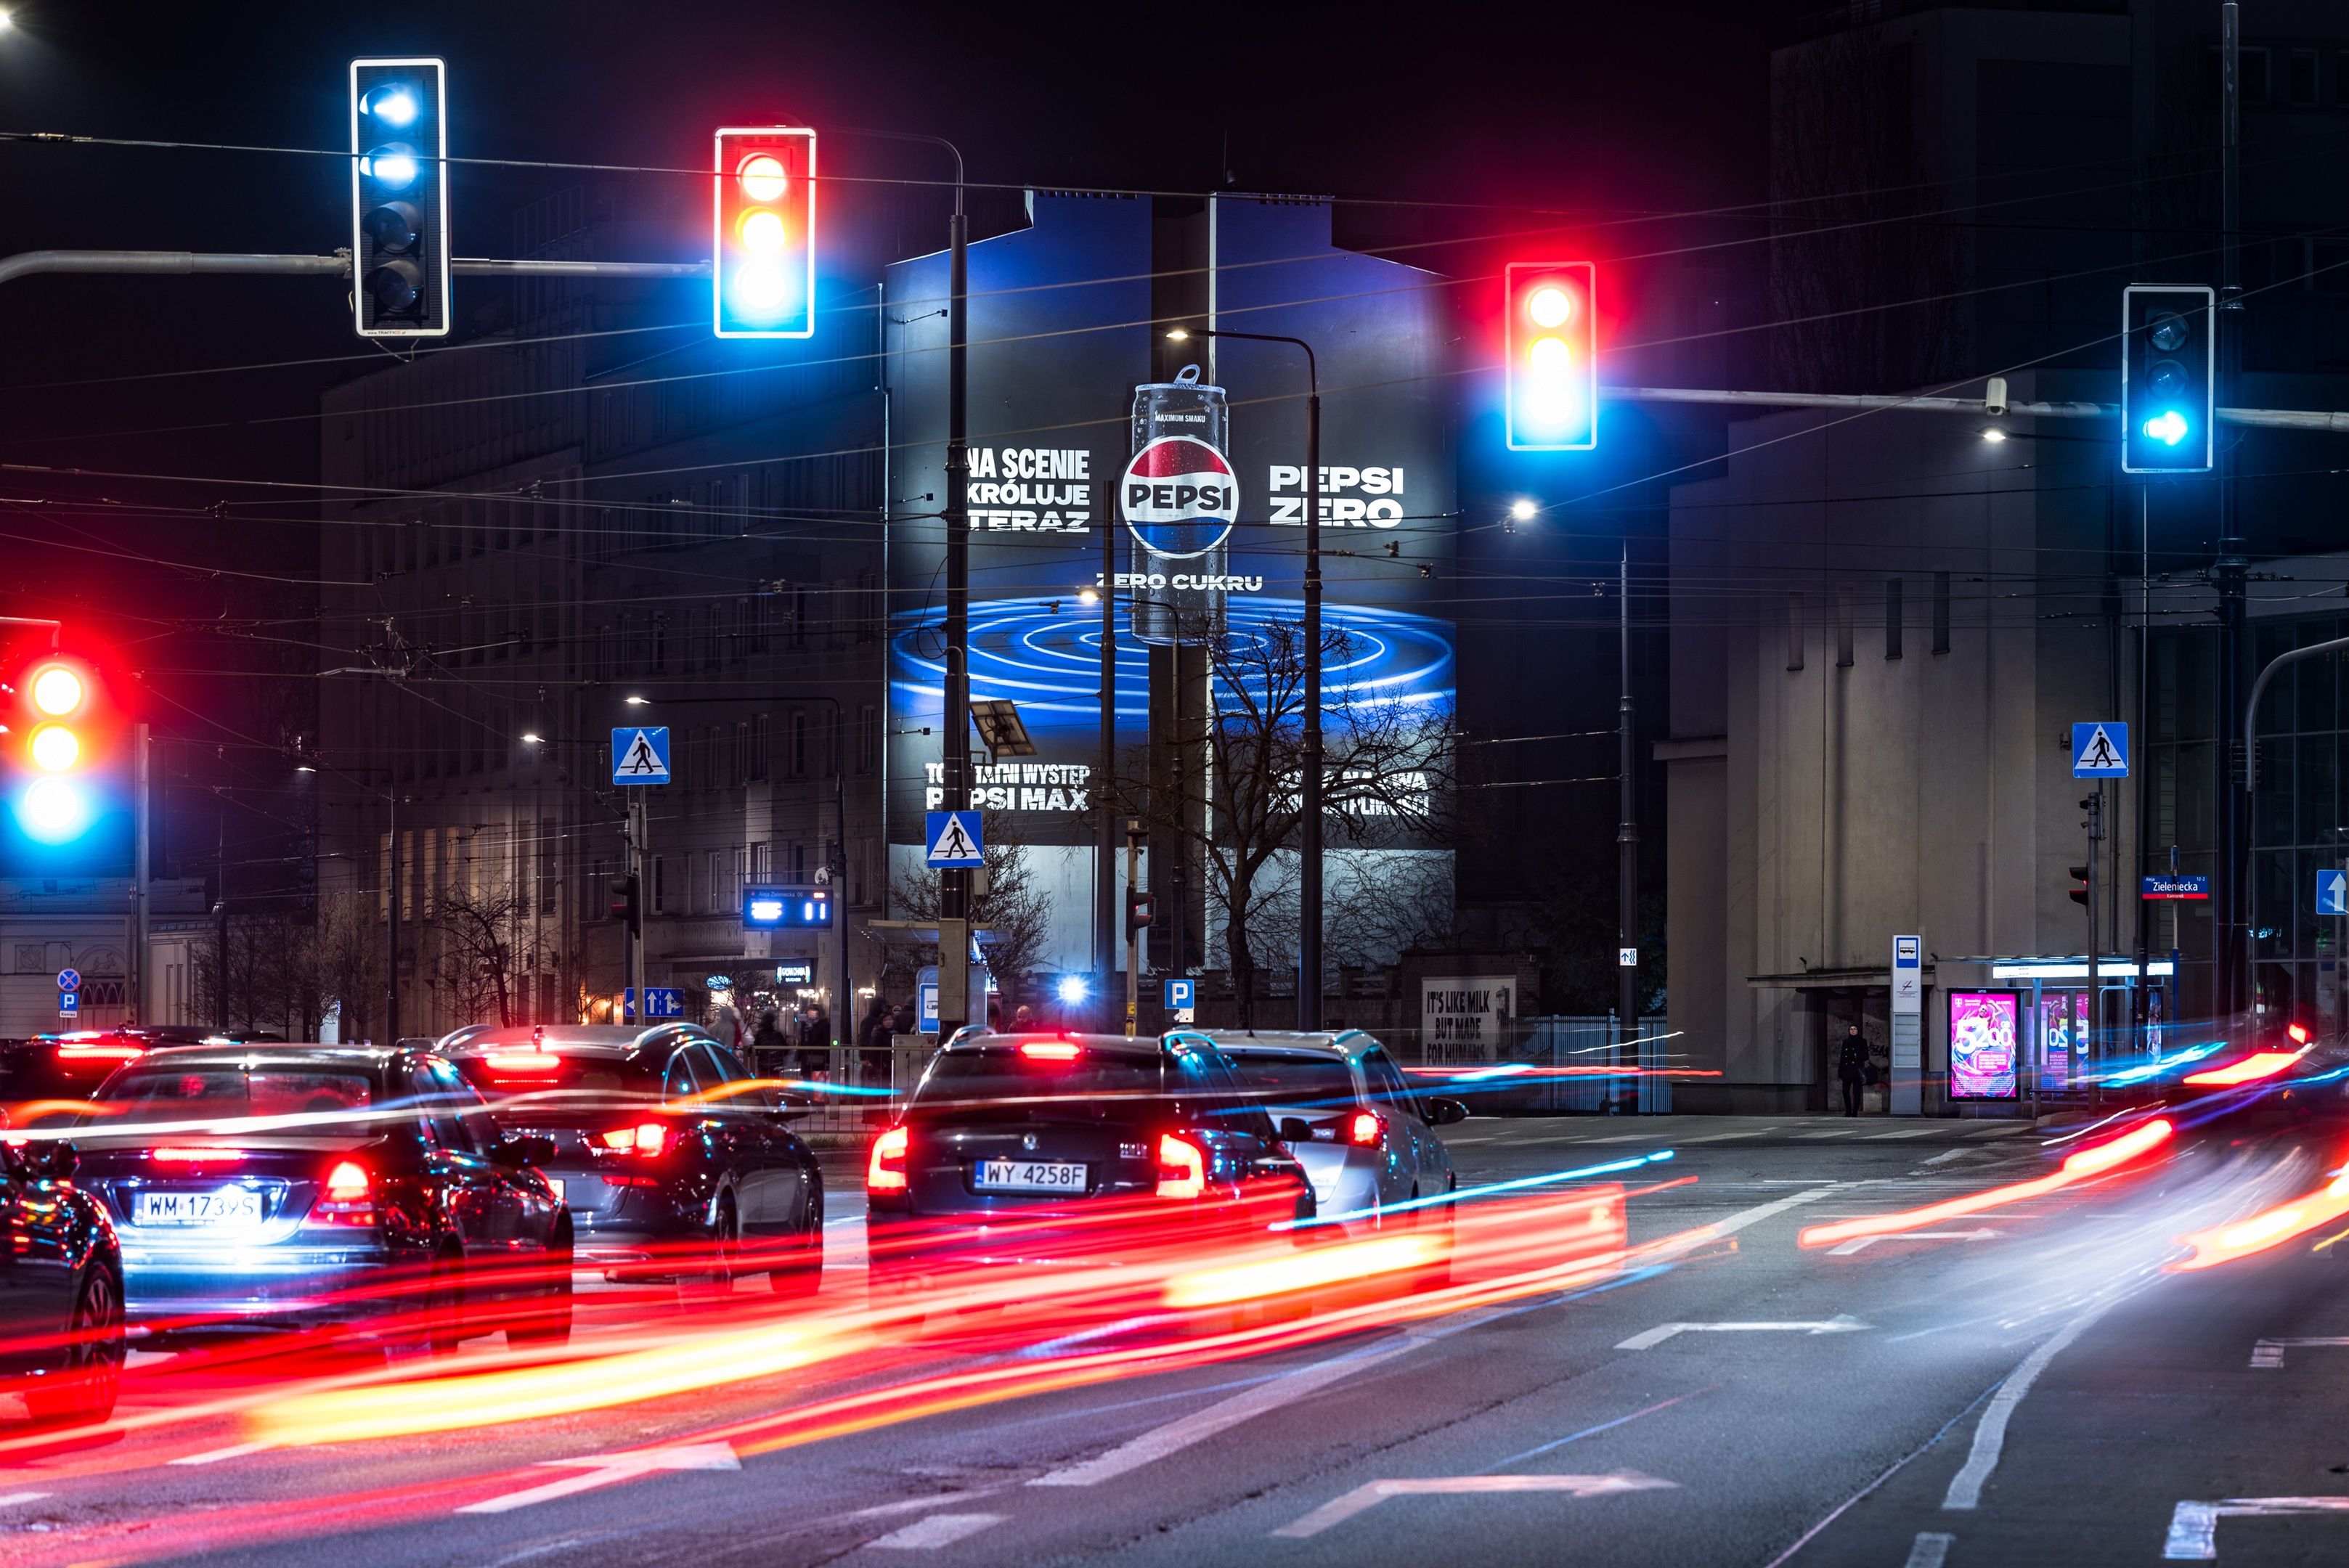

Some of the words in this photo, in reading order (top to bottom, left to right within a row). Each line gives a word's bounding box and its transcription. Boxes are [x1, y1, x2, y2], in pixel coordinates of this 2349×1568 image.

[1184, 415, 1206, 423] SMAKU
[967, 447, 998, 478] NA
[1001, 448, 1090, 480] SCENIE
[1269, 465, 1404, 494] PEPSI
[967, 478, 1090, 506] KRÓLUJE
[1128, 483, 1232, 511] PEPSI
[967, 509, 1090, 533] TERAZ
[1269, 497, 1404, 528] ZERO
[1096, 572, 1167, 589] ZERO
[1171, 573, 1263, 592] CUKRU
[926, 787, 1015, 810] PPSI
[1020, 788, 1090, 812] MAX
[2153, 881, 2198, 891] Zieleniecka
[63, 994, 75, 1008] P
[1171, 982, 1189, 1005] P
[1427, 991, 1444, 1013] IT'S
[1446, 991, 1465, 1013] LIKE
[1467, 990, 1490, 1013] MILK
[1435, 1017, 1453, 1040] BUT
[1455, 1017, 1481, 1040] MADE
[1427, 1043, 1444, 1066] FOR
[988, 1164, 1015, 1183] WY
[1023, 1165, 1083, 1184] 4258F
[150, 1196, 177, 1216] WM
[189, 1196, 254, 1216] 1739S
